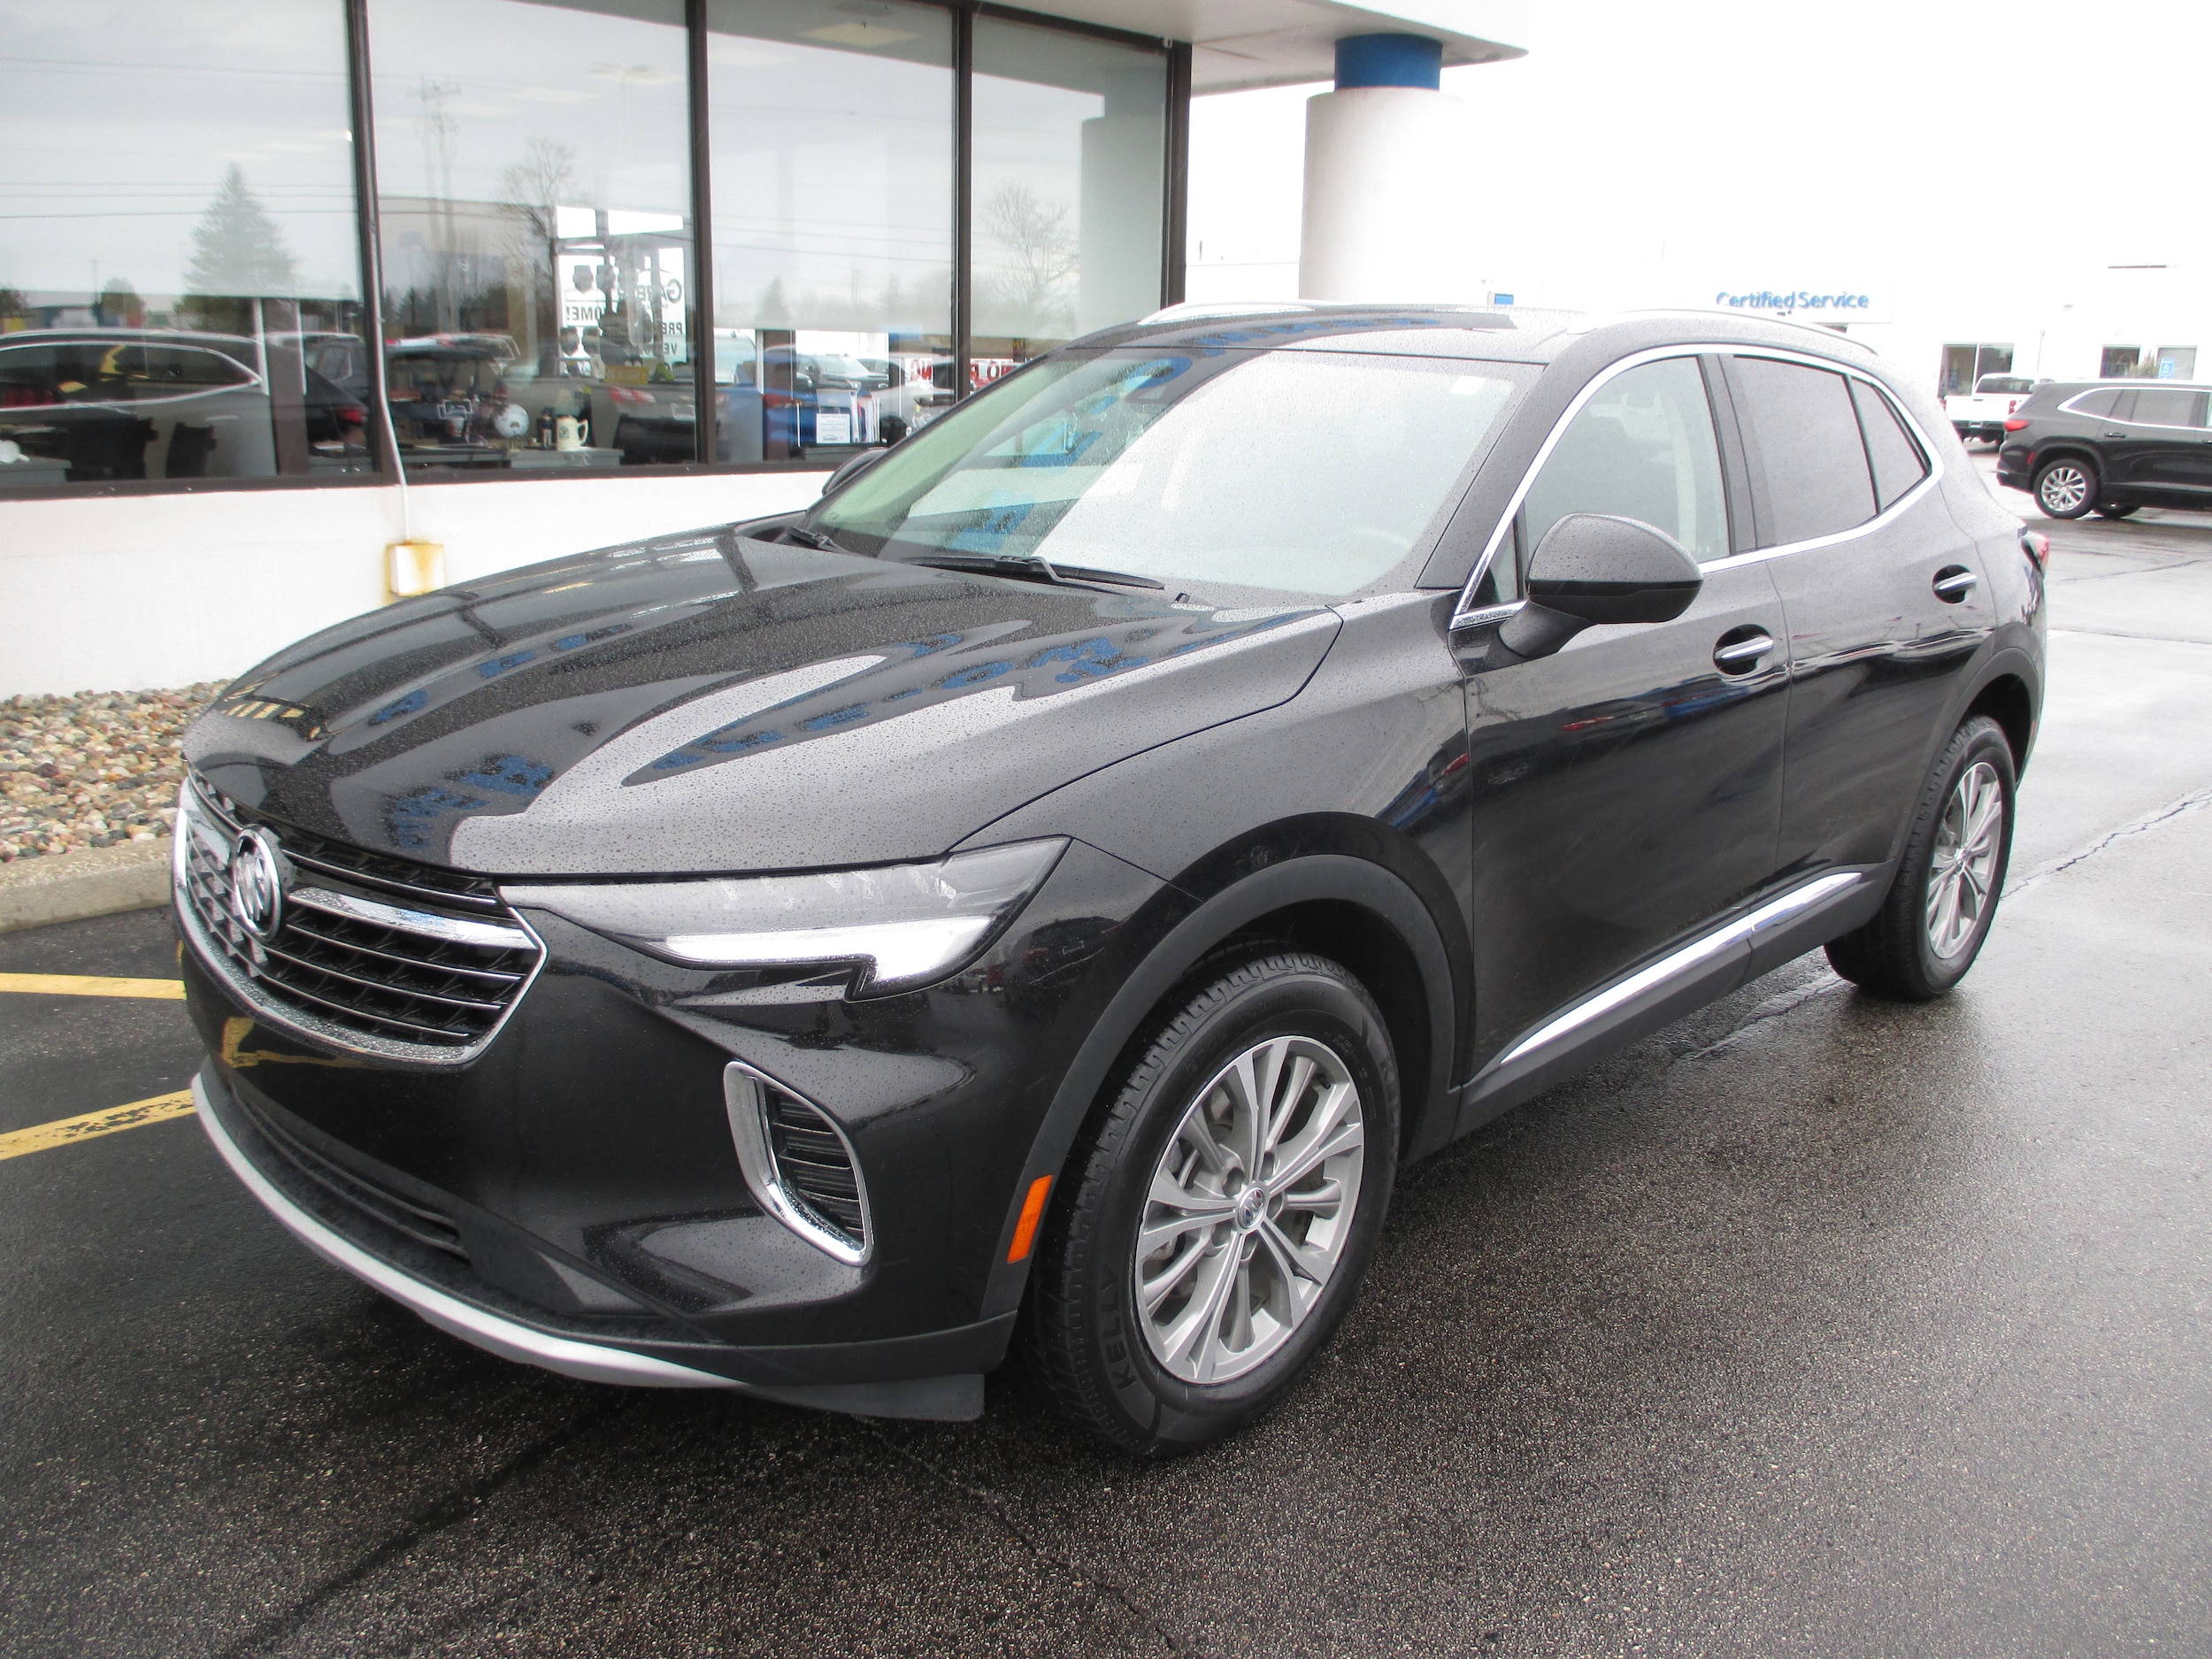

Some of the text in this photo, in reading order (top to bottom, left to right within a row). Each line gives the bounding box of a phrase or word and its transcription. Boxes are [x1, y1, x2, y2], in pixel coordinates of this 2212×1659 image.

[1716, 291, 1870, 309] Certified Service
[1101, 1266, 1138, 1392] KELLY
